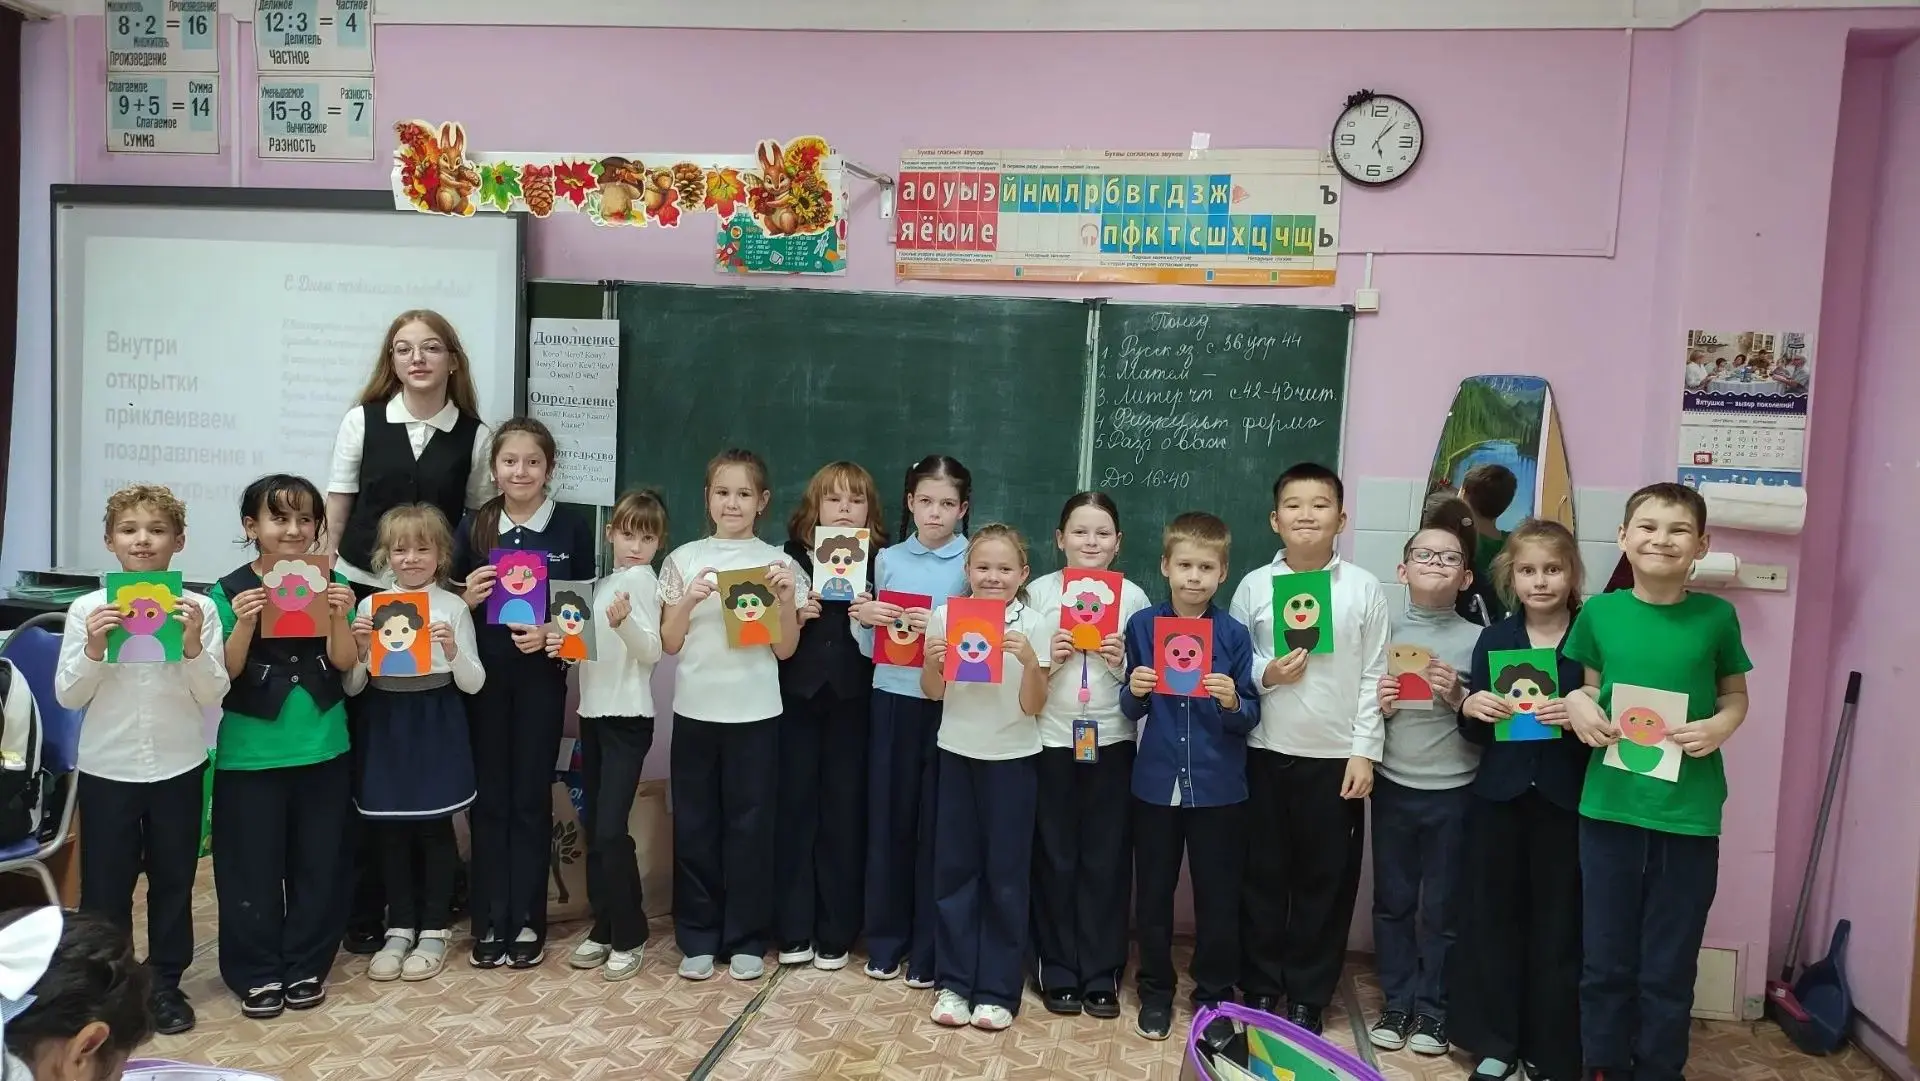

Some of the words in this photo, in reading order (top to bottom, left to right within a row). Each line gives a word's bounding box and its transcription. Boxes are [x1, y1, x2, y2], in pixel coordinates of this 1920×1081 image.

[189, 15, 207, 35] 16
[346, 12, 357, 33] 4
[285, 34, 322, 47] Делитель
[110, 51, 167, 67] Произведение
[269, 50, 310, 65] Частное
[109, 81, 148, 94] Слагаемое
[189, 82, 213, 94] Сумма
[261, 87, 305, 99] Уменьшаемое
[340, 87, 372, 100] Разность
[192, 97, 210, 117] 14
[353, 102, 365, 122] 7
[1372, 106, 1389, 117] 12
[136, 116, 177, 129] Слагаемое
[286, 122, 327, 134] Вычитаемое
[124, 133, 155, 148] Сумма
[269, 138, 316, 153] Разность
[1340, 134, 1355, 145] 9
[1398, 136, 1413, 148] 3
[1366, 165, 1381, 176] 6
[107, 331, 178, 361] Внутри
[534, 332, 615, 346] Дополнение
[1224, 333, 1244, 352] 36
[1282, 332, 1302, 348] 44
[1697, 335, 1718, 344] 2026
[106, 372, 198, 395] открытки
[531, 392, 615, 407] Определение
[1696, 399, 1724, 407] Вятушка
[106, 408, 237, 430] приклеиваем
[1243, 413, 1326, 447] форма
[104, 443, 246, 467] поздравление
[253, 451, 264, 466] и
[1101, 467, 1134, 488] До
[1141, 470, 1189, 489] 16:40
